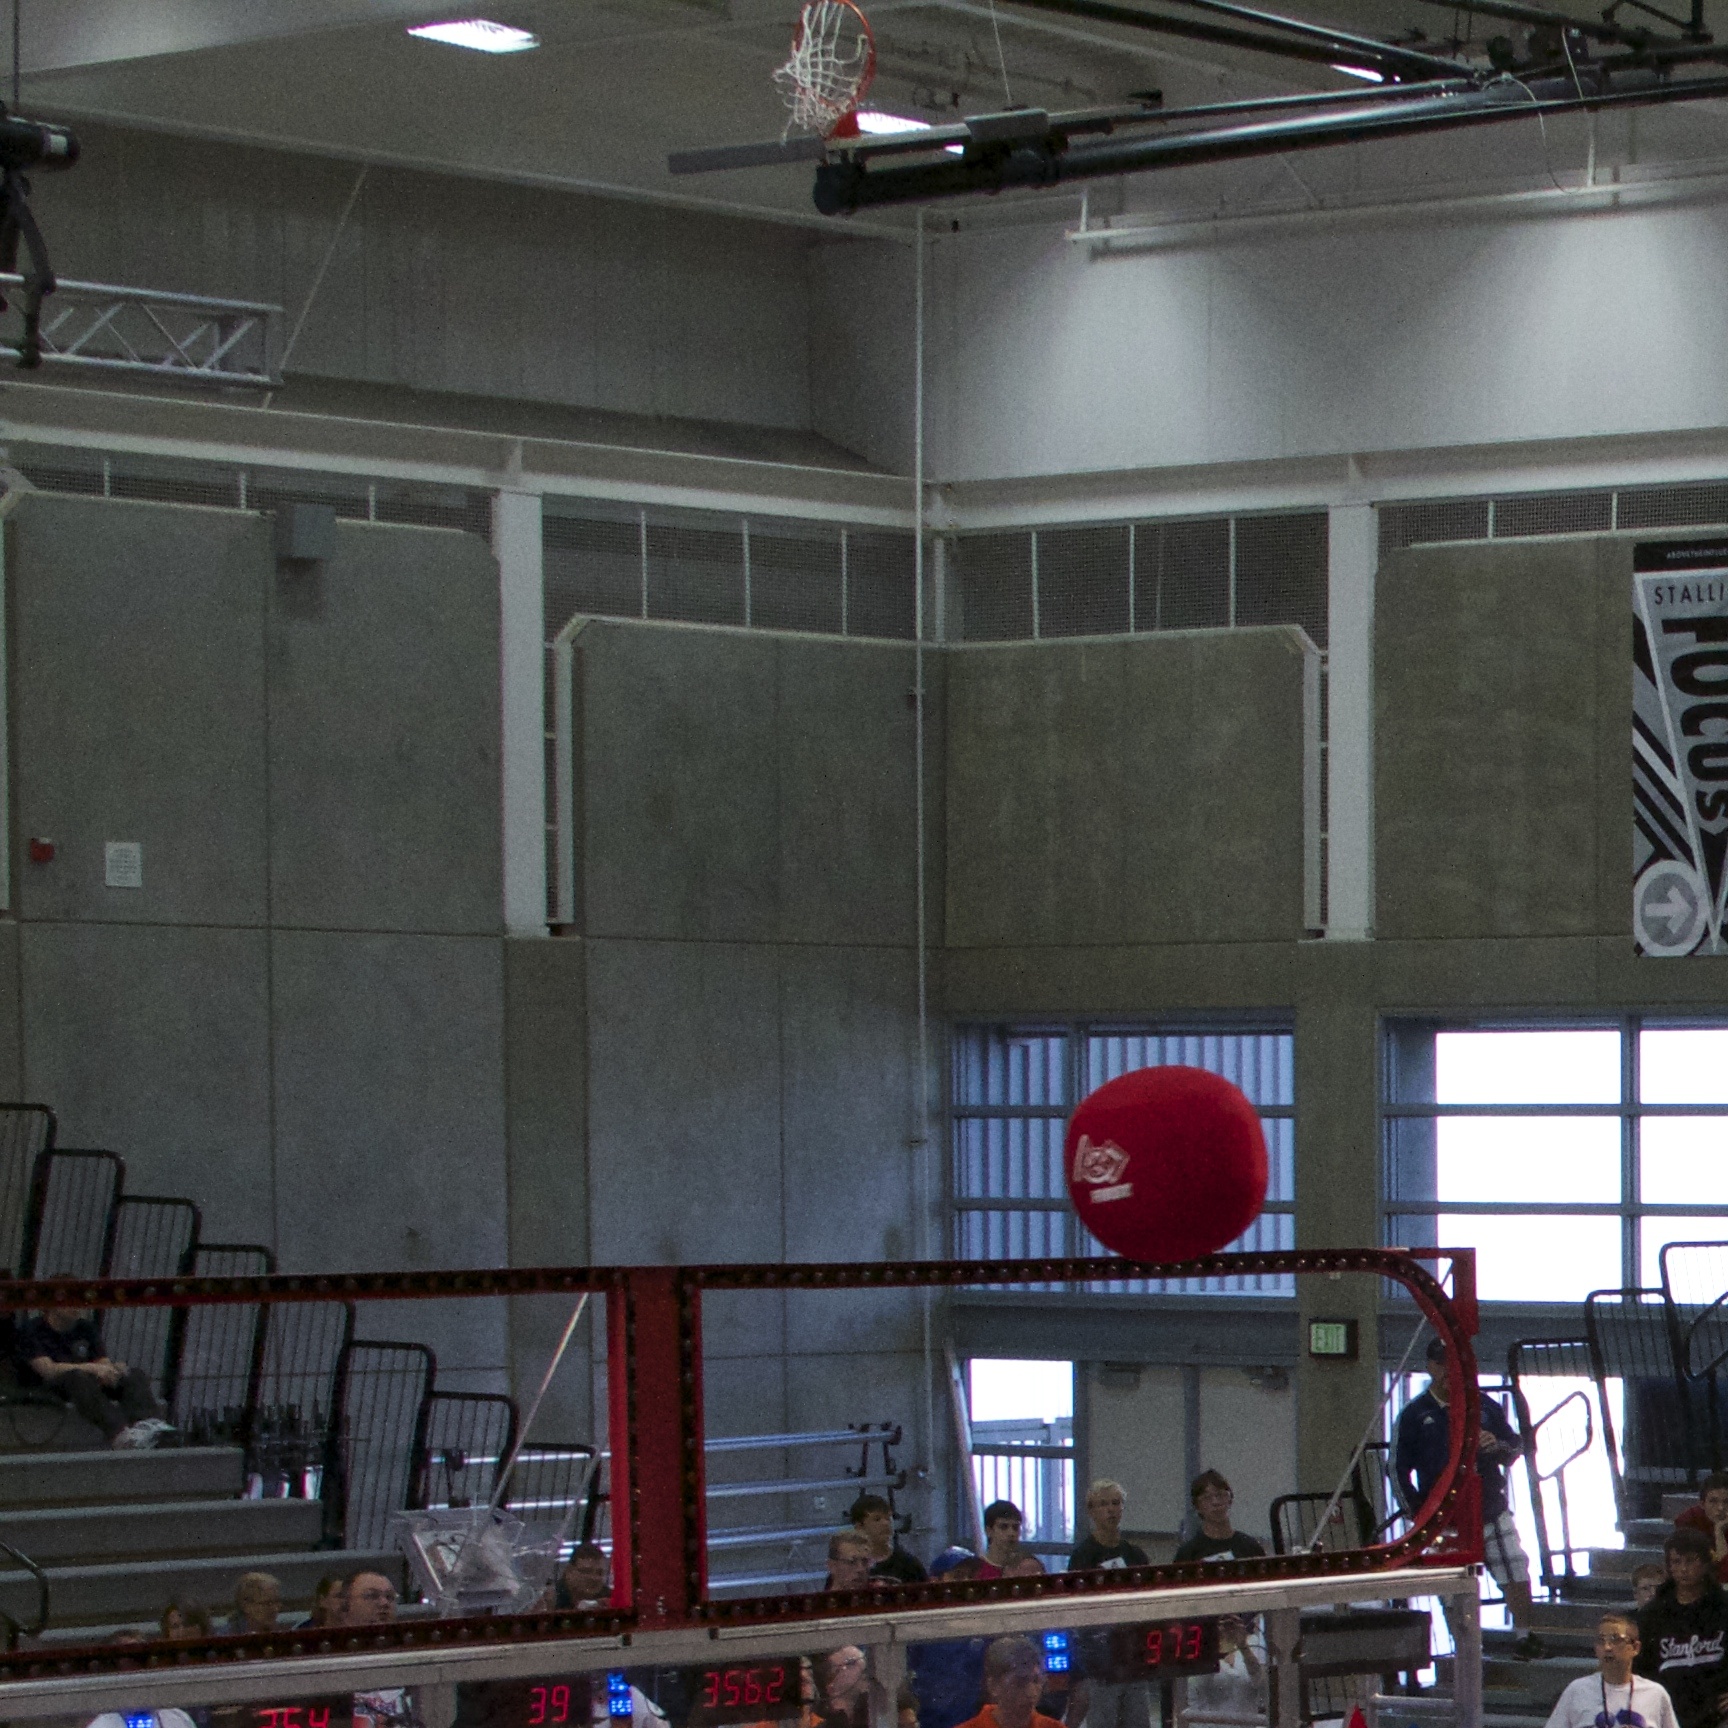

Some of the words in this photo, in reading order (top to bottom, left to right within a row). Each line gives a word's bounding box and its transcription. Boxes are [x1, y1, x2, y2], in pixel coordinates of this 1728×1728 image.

[1144, 1625, 1203, 1665] 973
[1659, 1630, 1726, 1660] Stanford
[528, 1684, 571, 1724] 39
[702, 1666, 786, 1708] 3562
